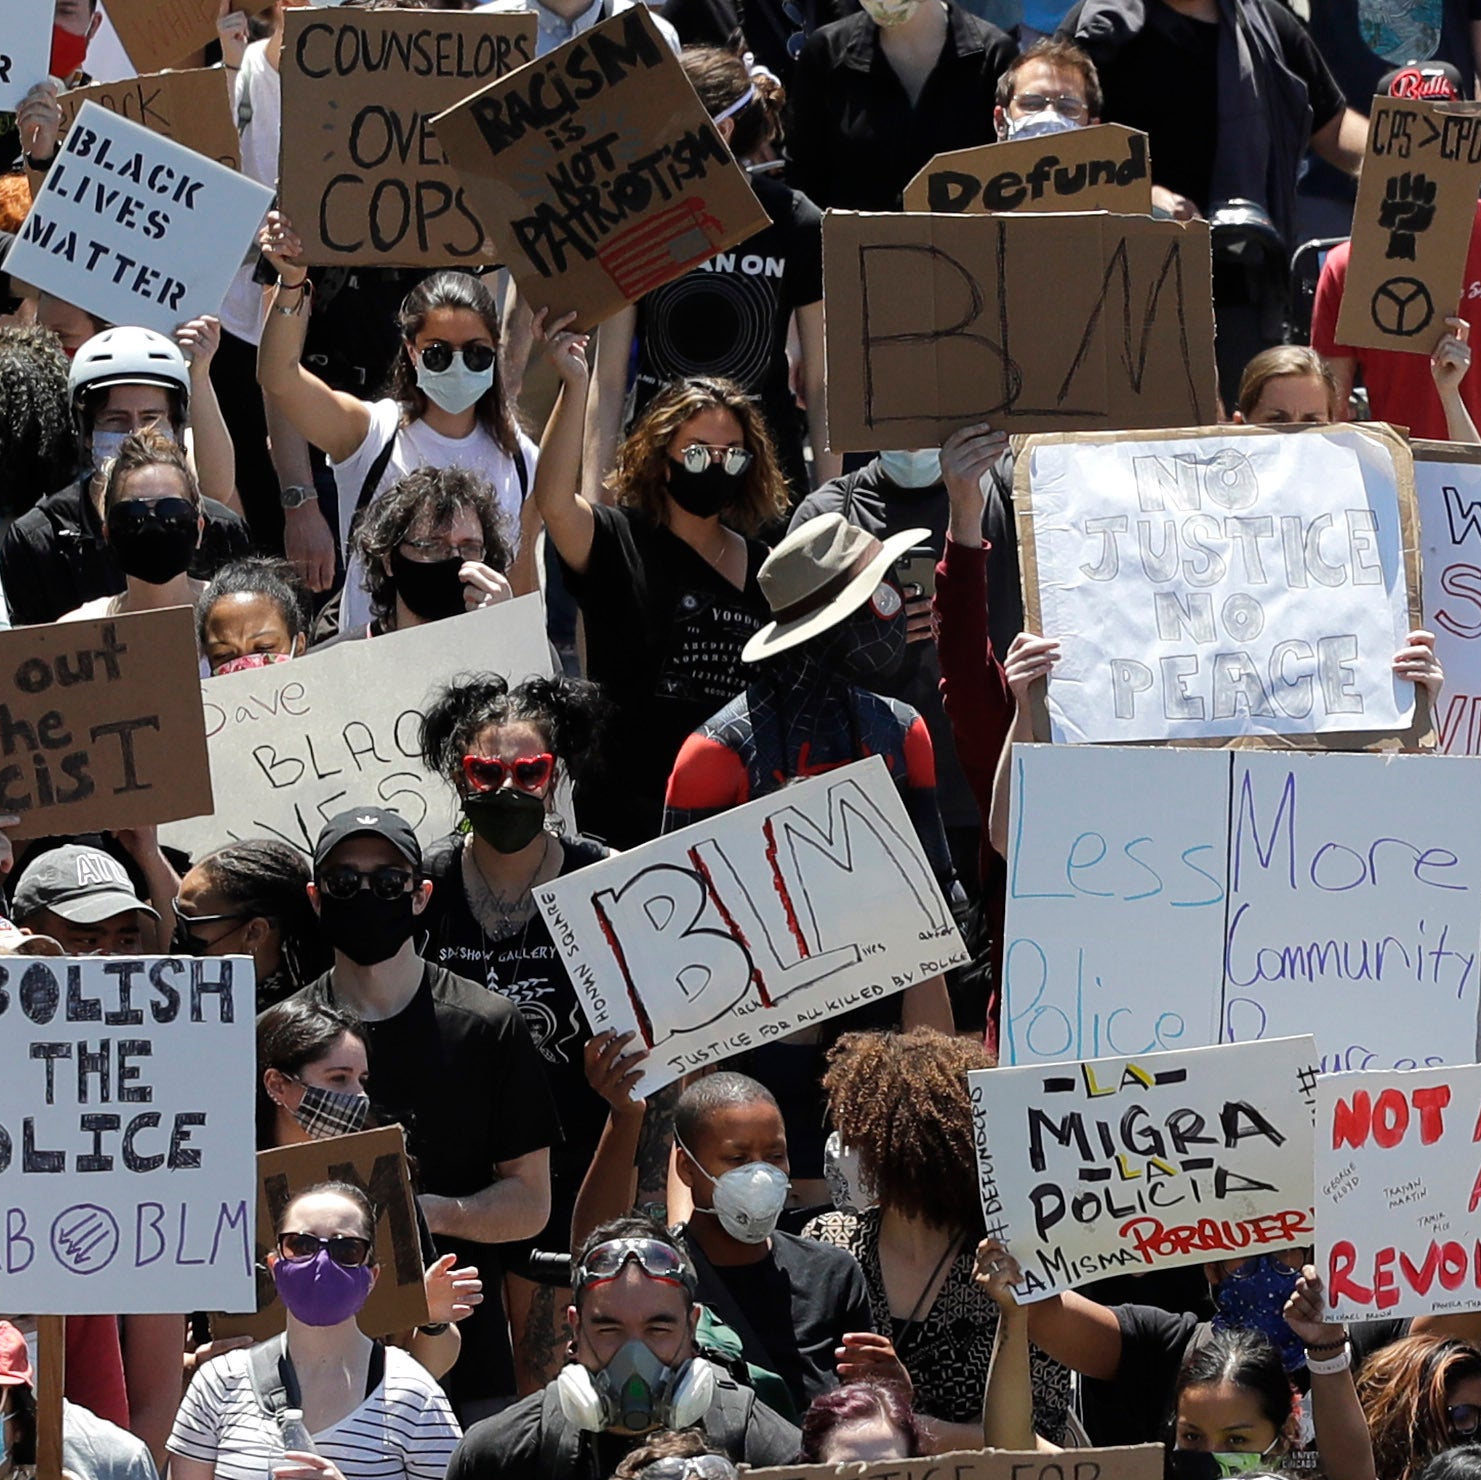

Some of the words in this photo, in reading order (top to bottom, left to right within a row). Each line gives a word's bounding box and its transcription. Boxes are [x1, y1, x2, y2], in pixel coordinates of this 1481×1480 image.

[297, 22, 531, 79] COUNSELORS
[46, 164, 170, 241] LIVES
[67, 124, 204, 211] BLACK
[321, 174, 485, 258] COPS
[23, 213, 187, 312] MATTER
[1133, 447, 1261, 513] NO
[1079, 505, 1384, 590] JUSTICE
[1154, 590, 1266, 646] NO
[13, 623, 129, 695] out
[1109, 632, 1366, 723] PEACE
[1010, 757, 1228, 908] Less
[1235, 767, 1471, 894] More
[667, 1032, 753, 1074] JUSTICE
[758, 1014, 792, 1038] FOR
[825, 983, 885, 1016] KILLED
[891, 968, 914, 989] BY
[28, 1037, 153, 1105] THE
[1028, 1100, 1288, 1173] MIGRA
[1333, 1084, 1452, 1151] NOT
